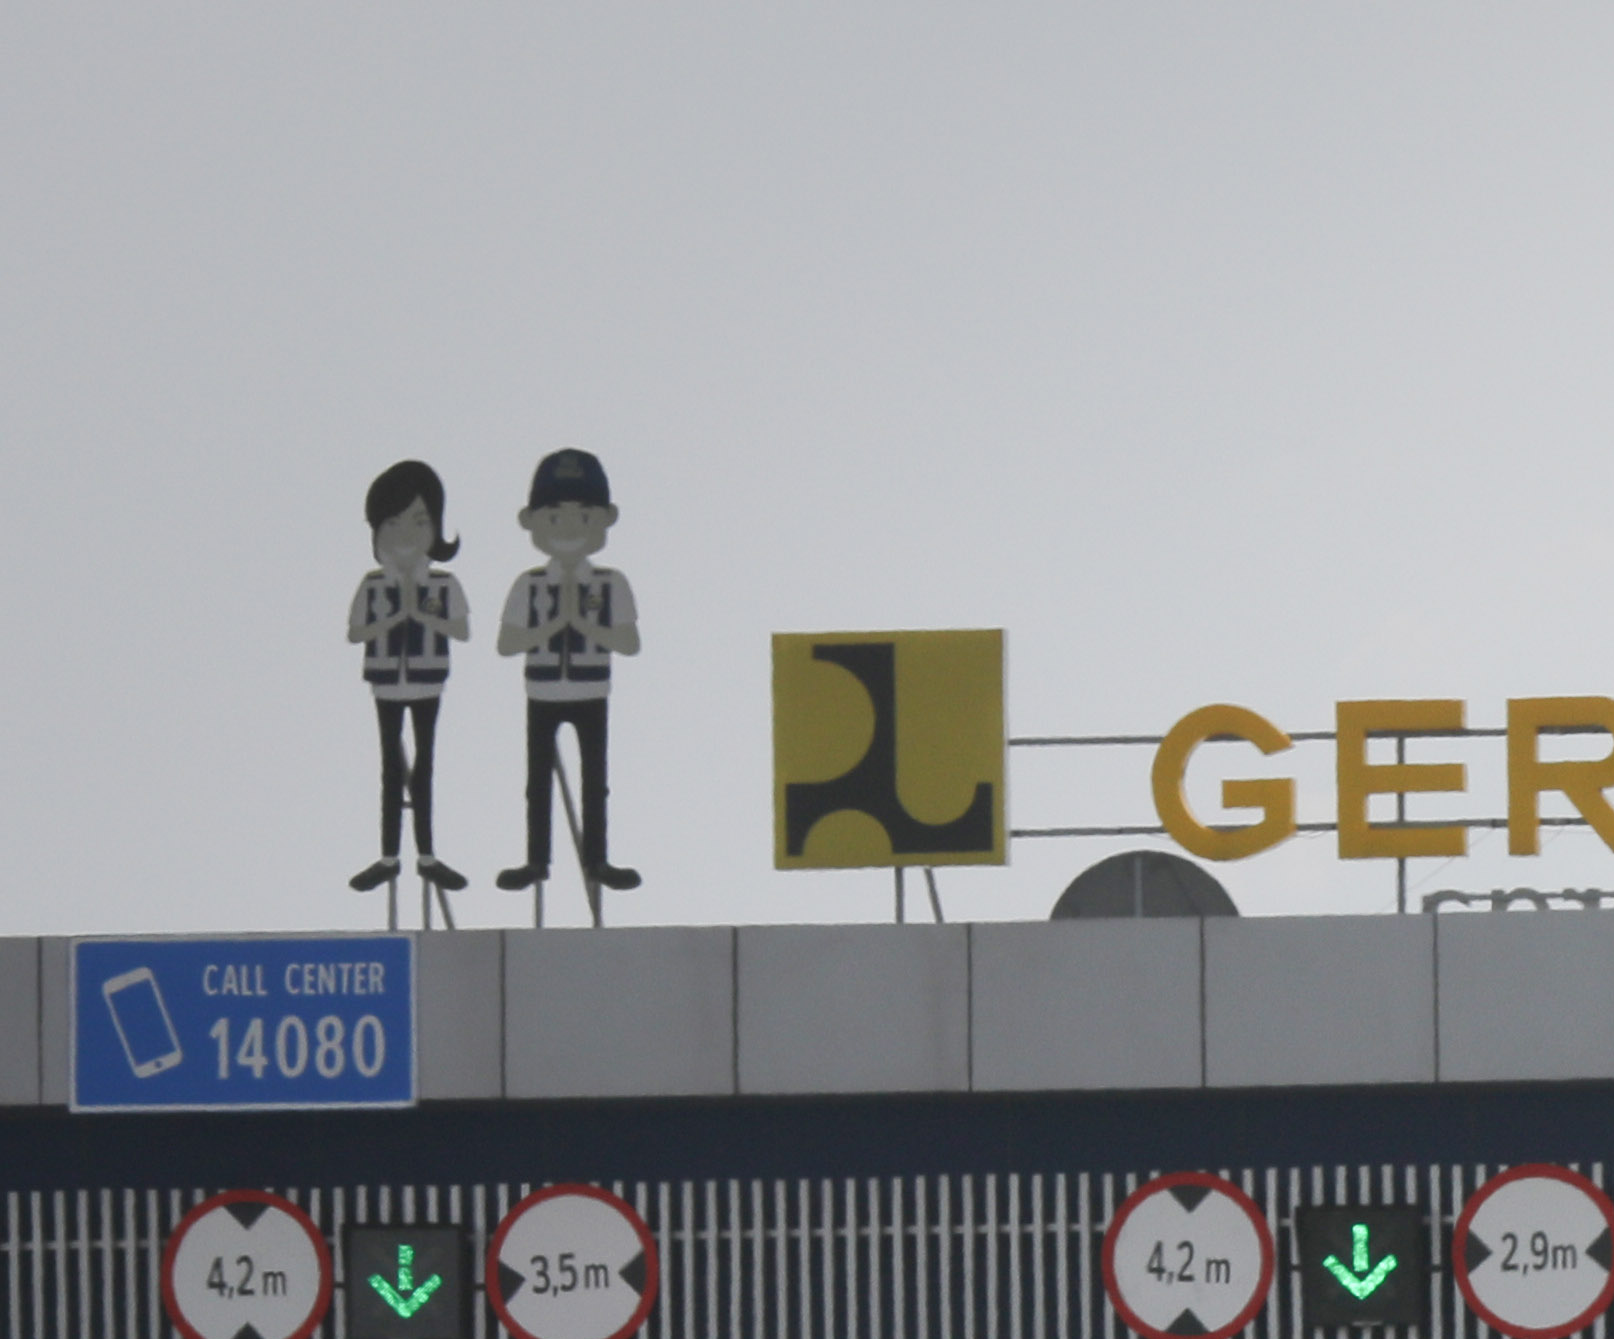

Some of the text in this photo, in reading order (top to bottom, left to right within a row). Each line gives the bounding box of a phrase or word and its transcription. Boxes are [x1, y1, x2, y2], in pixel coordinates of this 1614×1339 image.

[203, 960, 386, 998] CALL CENTER
[206, 1016, 386, 1082] 14080
